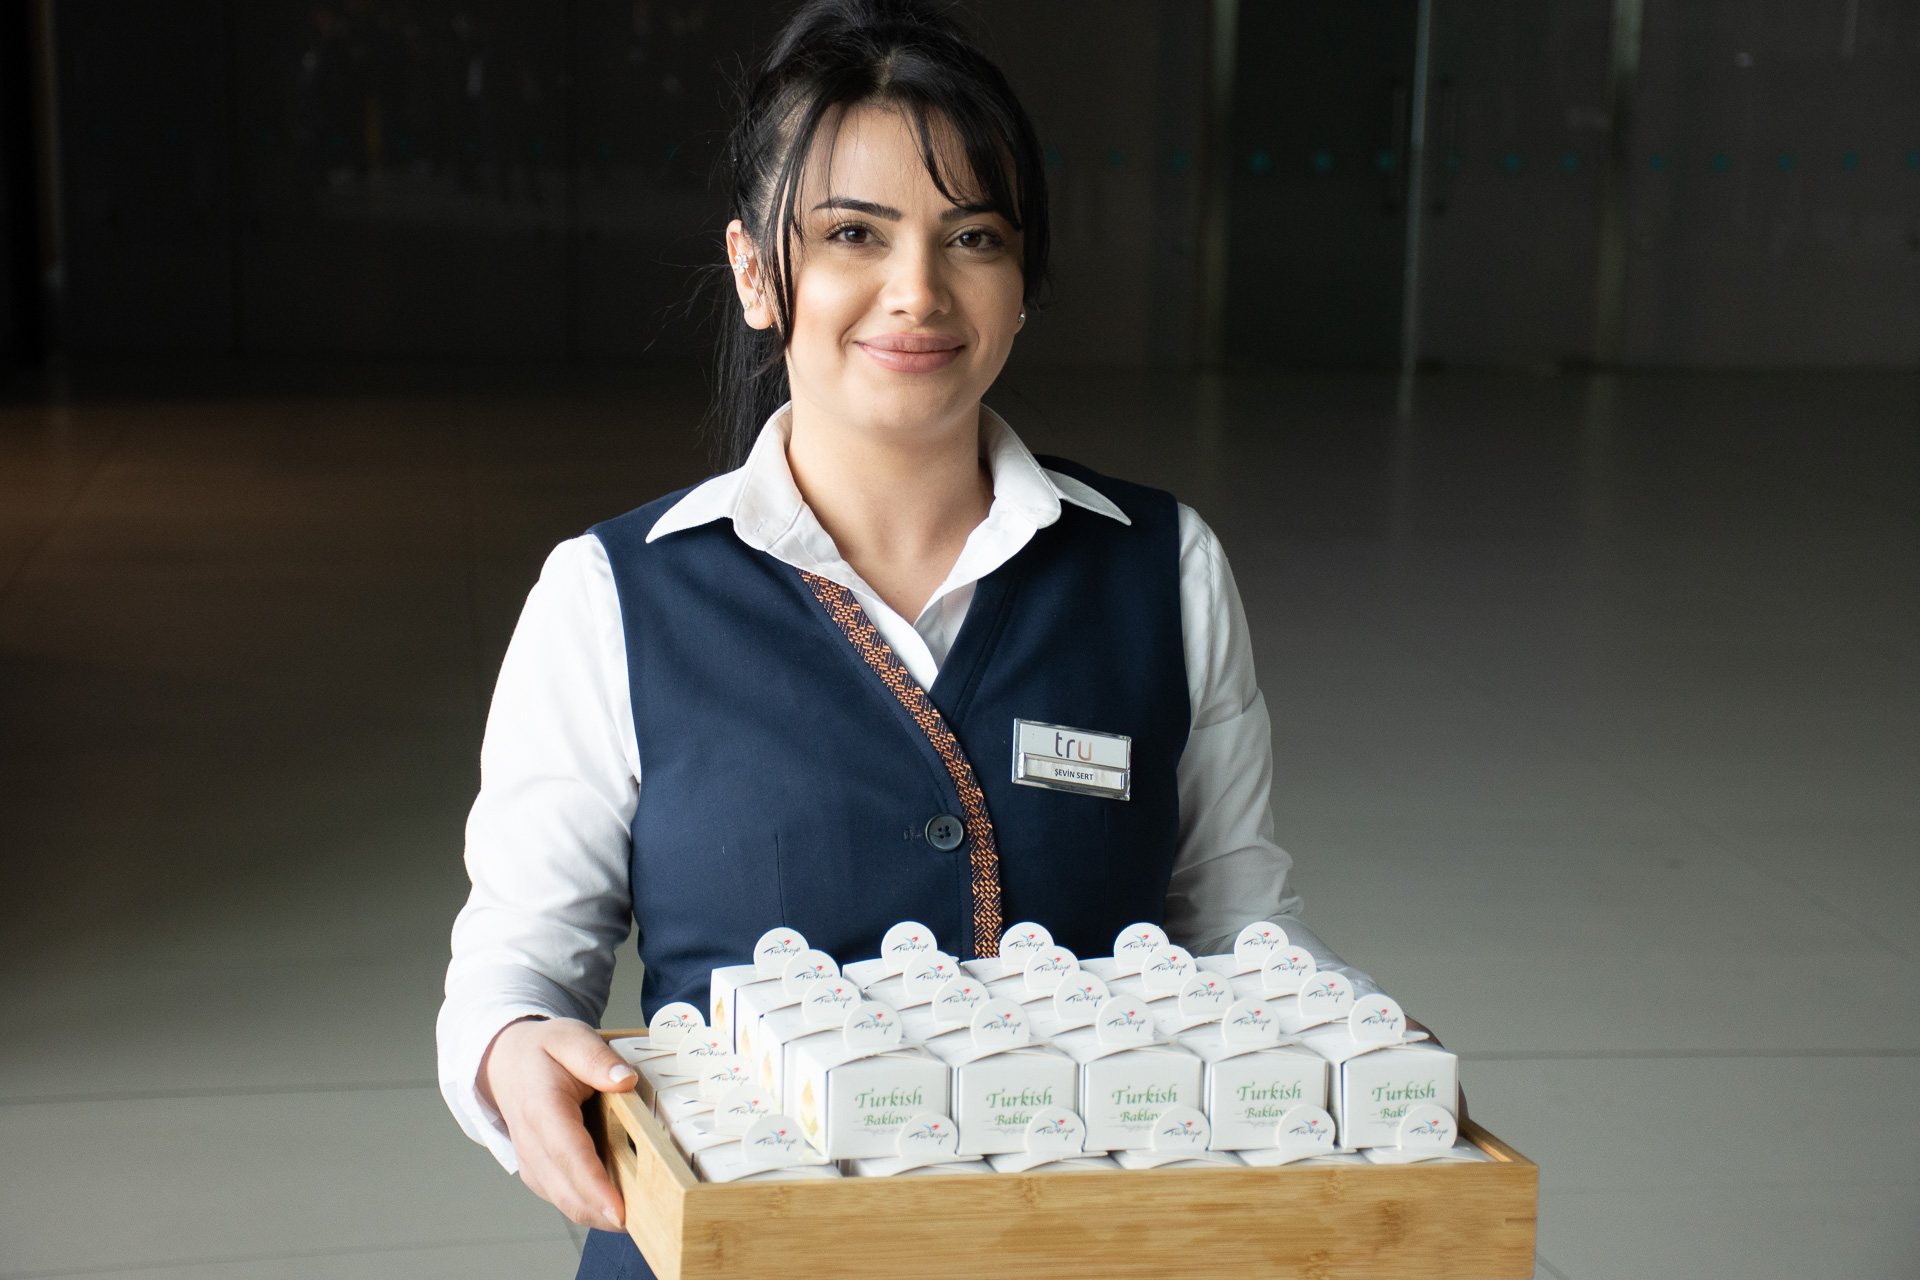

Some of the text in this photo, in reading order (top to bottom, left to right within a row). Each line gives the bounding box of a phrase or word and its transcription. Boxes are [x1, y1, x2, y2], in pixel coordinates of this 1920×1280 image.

[1055, 732, 1092, 761] tru
[1054, 768, 1094, 781] ŞEVİN SERT
[854, 1086, 923, 1109] Turkish
[986, 1086, 1053, 1108] Turkish
[1111, 1083, 1178, 1106] Turkish
[1236, 1080, 1302, 1101] Turkish
[1371, 1079, 1437, 1102] Turkish
[995, 1111, 1032, 1126] Bakla
[1120, 1107, 1160, 1123] Baklav
[1245, 1104, 1286, 1119] Baklav
[1381, 1104, 1409, 1119] Bakl
